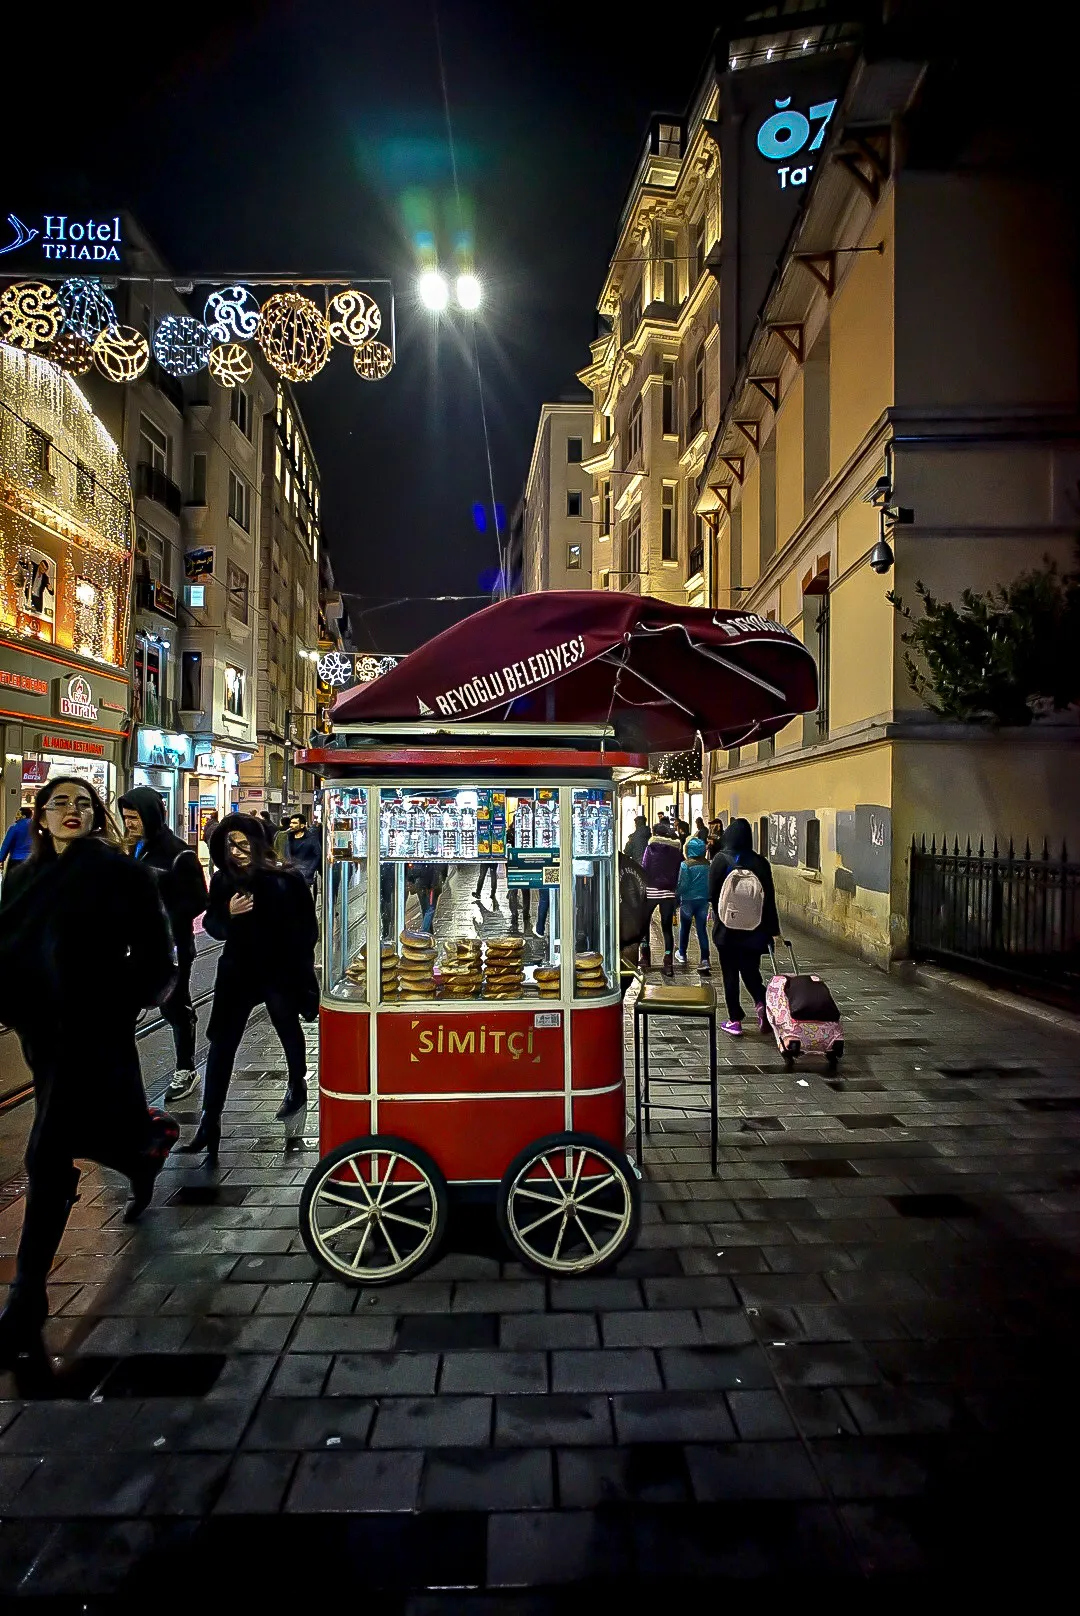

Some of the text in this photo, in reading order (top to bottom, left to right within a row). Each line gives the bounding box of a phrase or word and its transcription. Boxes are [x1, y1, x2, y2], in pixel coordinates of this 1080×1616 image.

[777, 166, 814, 189] Ta
[43, 215, 122, 242] Hotel
[435, 635, 585, 715] BEYOĞLU BELEDİYESİ
[61, 697, 98, 720] Burak
[418, 1024, 534, 1060] SİMİTÇİ
